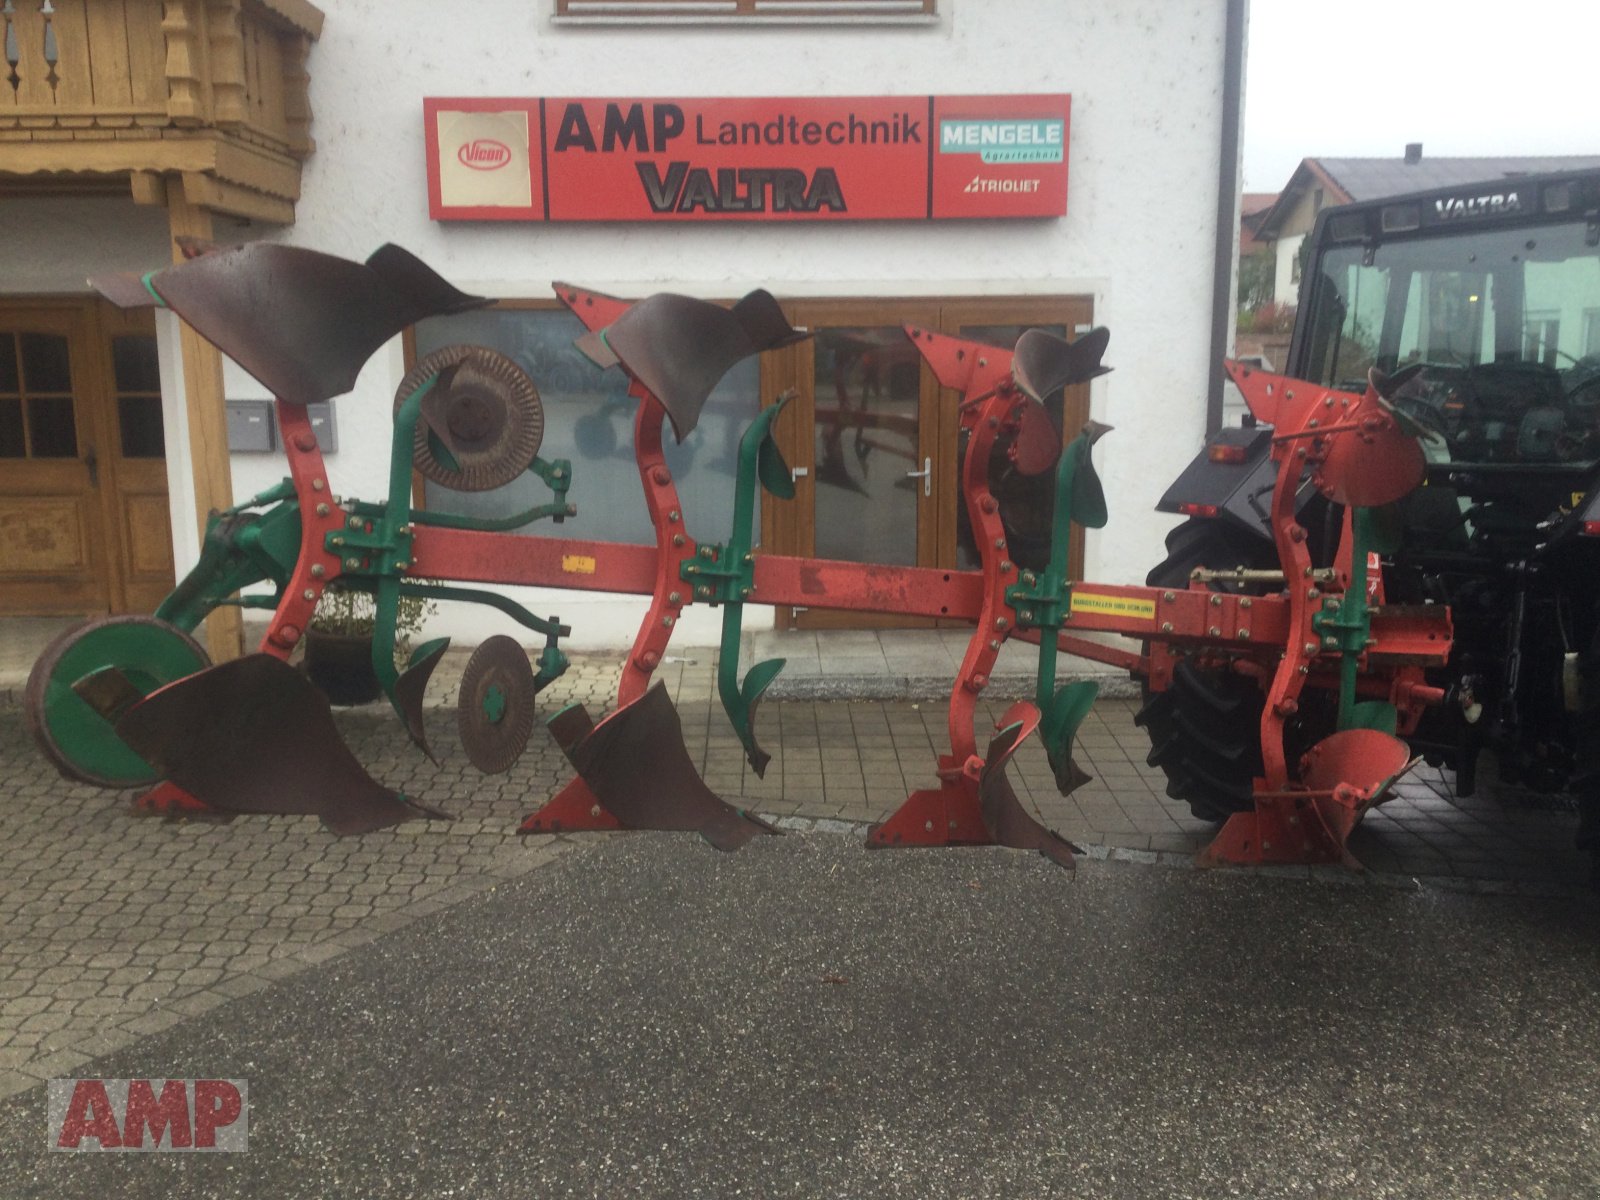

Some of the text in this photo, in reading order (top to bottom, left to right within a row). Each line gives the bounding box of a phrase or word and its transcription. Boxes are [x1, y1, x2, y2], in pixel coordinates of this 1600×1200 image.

[554, 103, 922, 153] AMP Landtechnik
[943, 124, 1061, 146] MENGELE
[465, 141, 505, 162] Vicon
[984, 150, 1060, 162] Agrartechnik
[634, 161, 848, 214] VALTRA
[979, 179, 1041, 193] TRIOLIET
[1435, 192, 1521, 219] VALTRA
